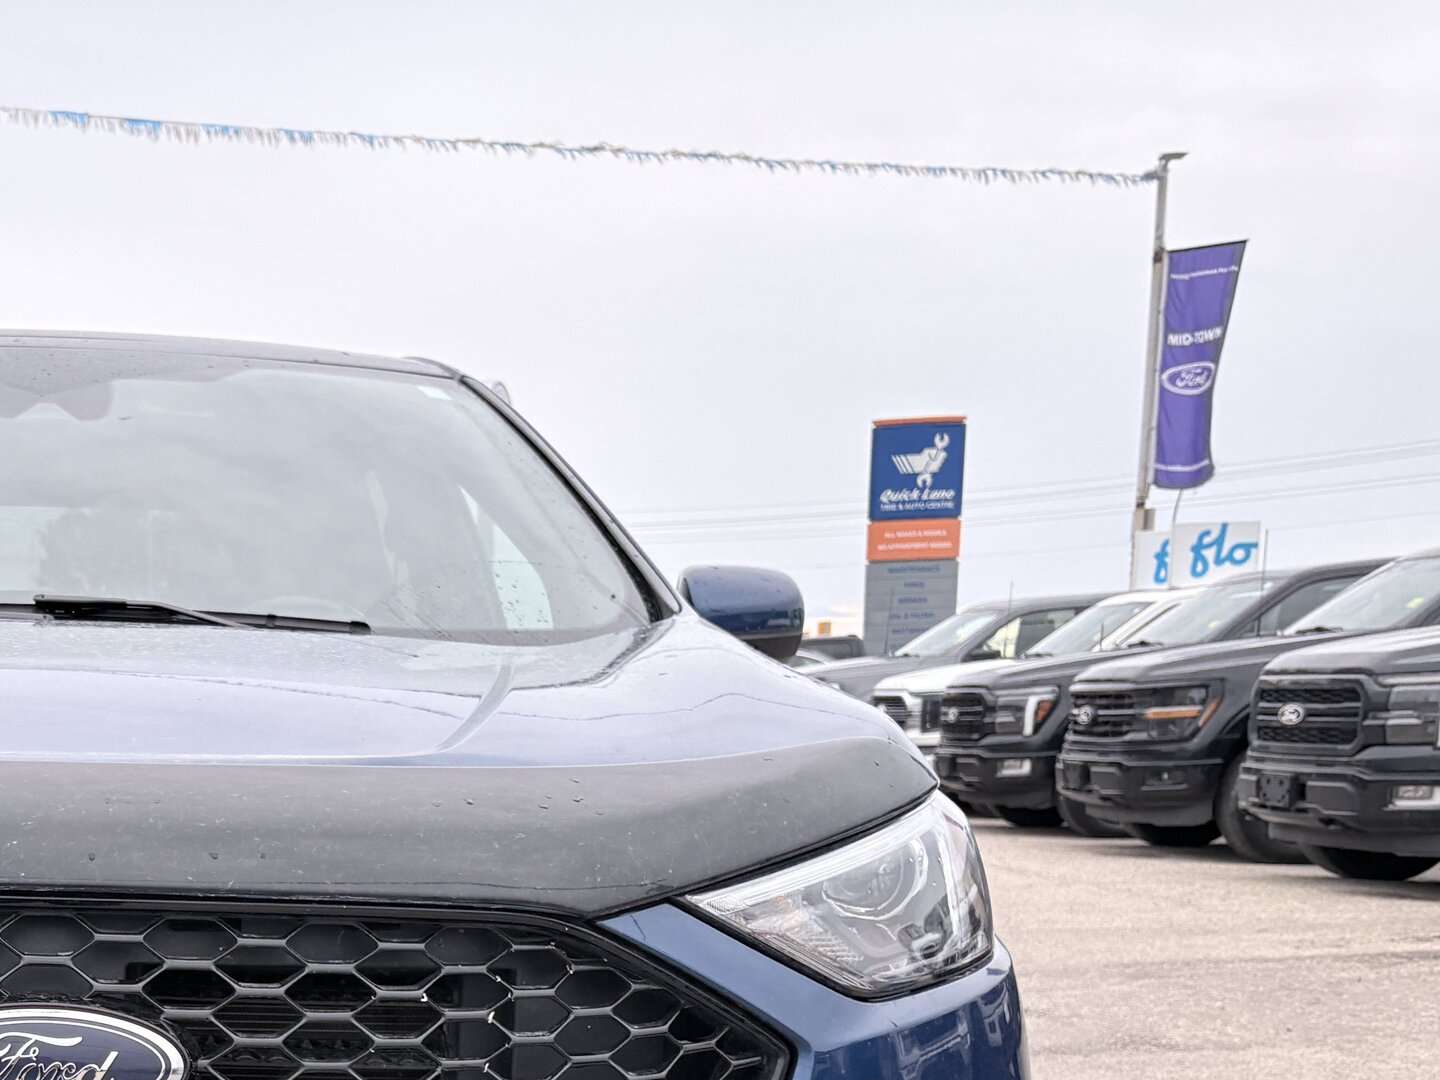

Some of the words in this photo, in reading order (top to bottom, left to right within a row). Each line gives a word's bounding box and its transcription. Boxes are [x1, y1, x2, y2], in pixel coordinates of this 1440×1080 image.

[1175, 368, 1209, 388] Ford
[880, 488, 920, 503] Quick
[921, 488, 956, 501] Lane
[1191, 522, 1258, 577] flo
